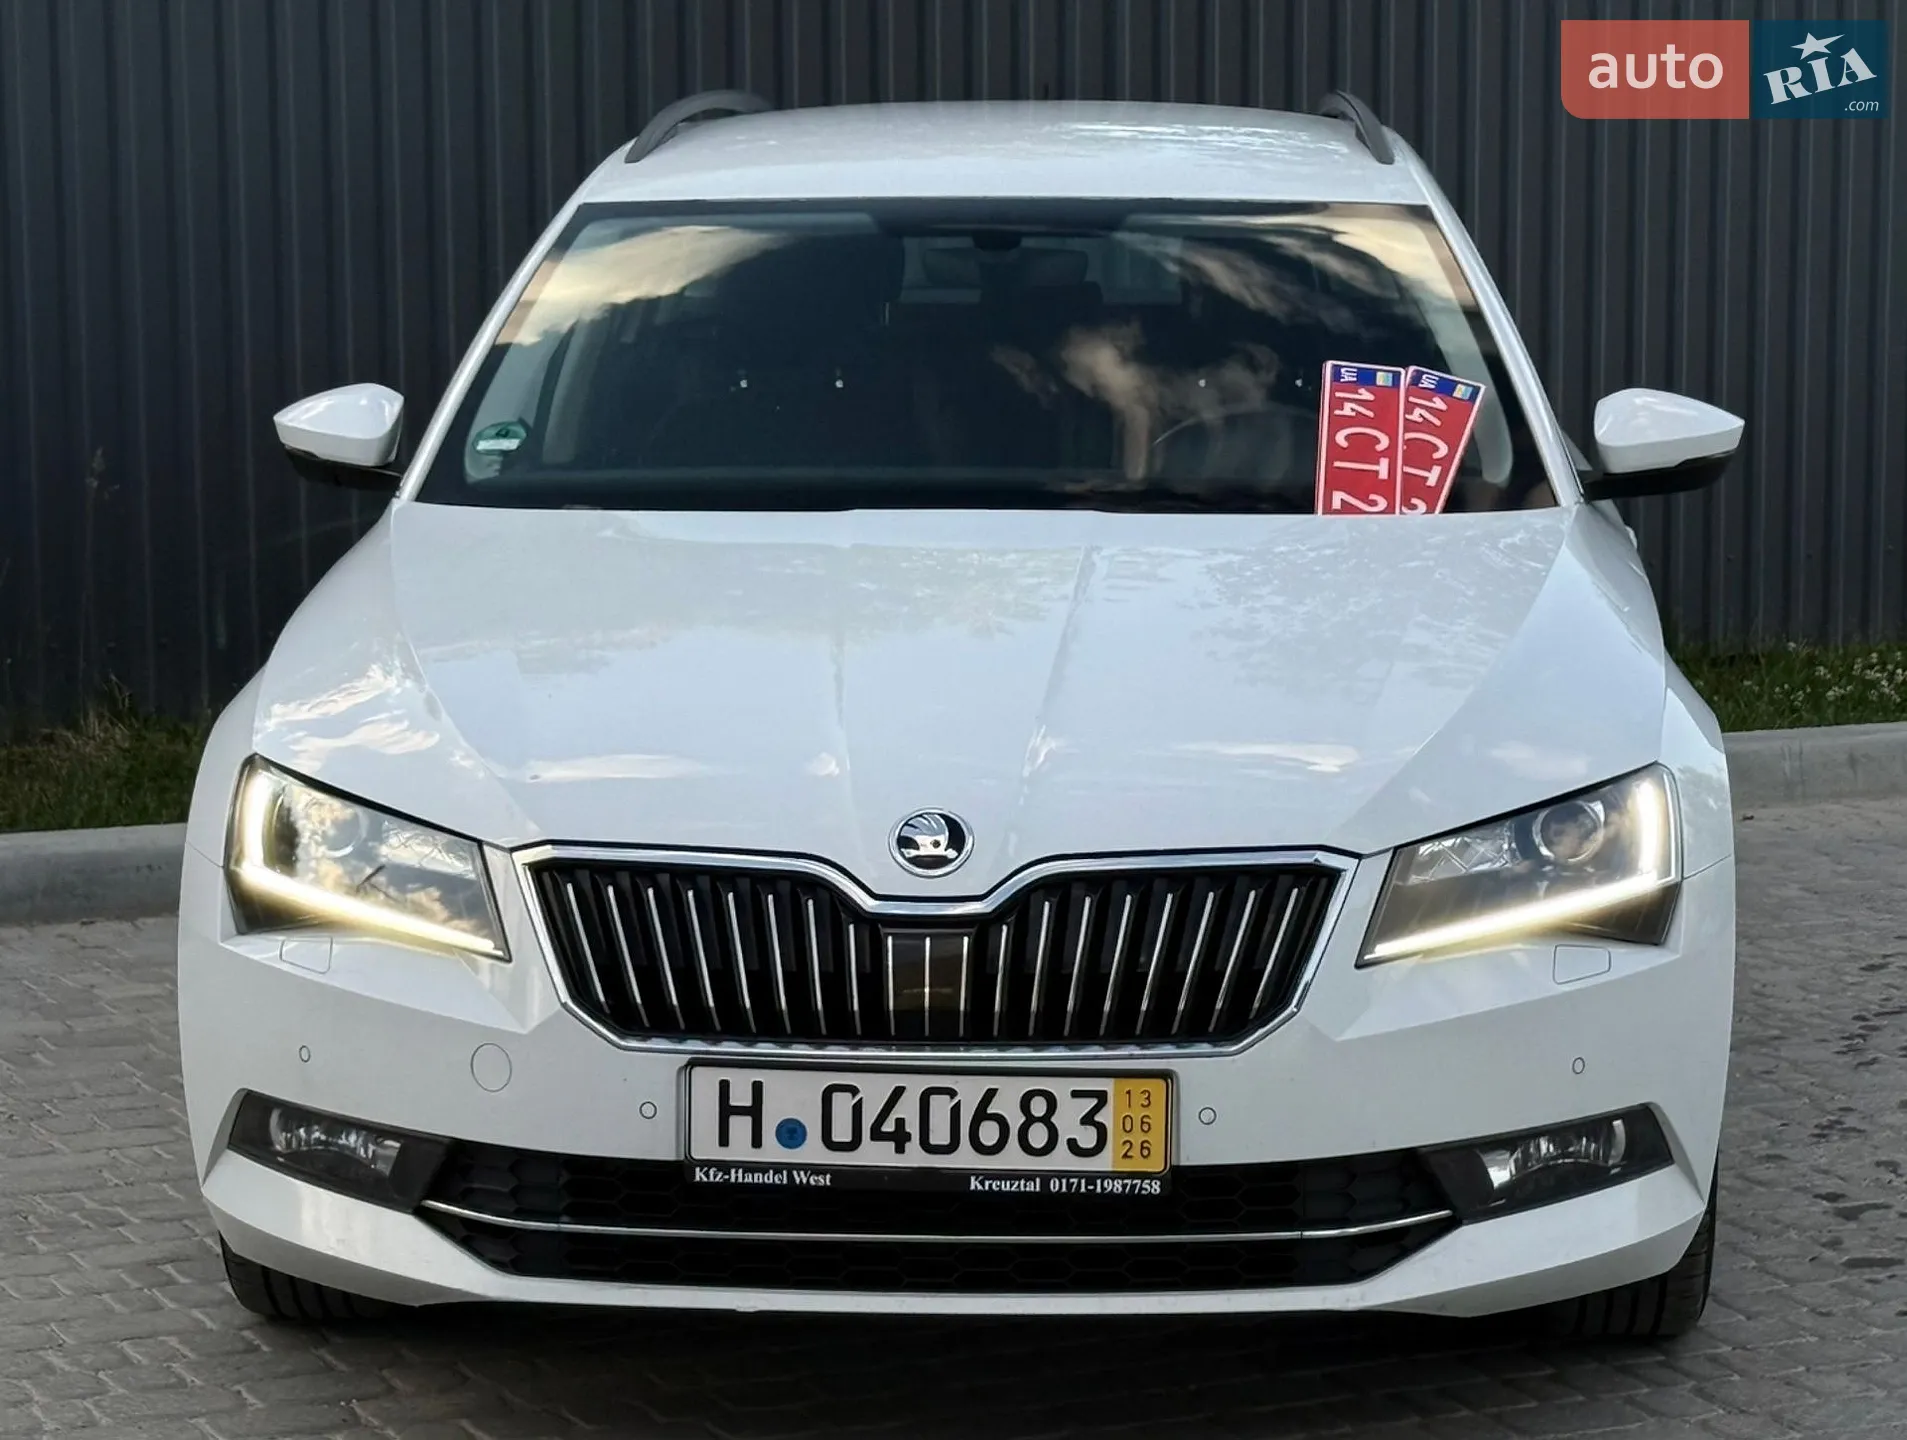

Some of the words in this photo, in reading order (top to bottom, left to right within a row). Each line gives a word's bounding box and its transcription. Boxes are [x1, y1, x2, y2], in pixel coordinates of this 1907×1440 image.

[1340, 367, 1358, 383] UA
[1418, 373, 1440, 390] UA
[1125, 1088, 1152, 1109] 13
[717, 1078, 764, 1149] H
[820, 1082, 1109, 1159] 040683
[1121, 1114, 1153, 1134] 06
[1121, 1139, 1153, 1159] 26
[693, 1166, 788, 1185] Kfz-Handel
[792, 1169, 832, 1186] West
[969, 1175, 1041, 1192] Kreuztal
[1049, 1177, 1162, 1195] 0171-1987758
